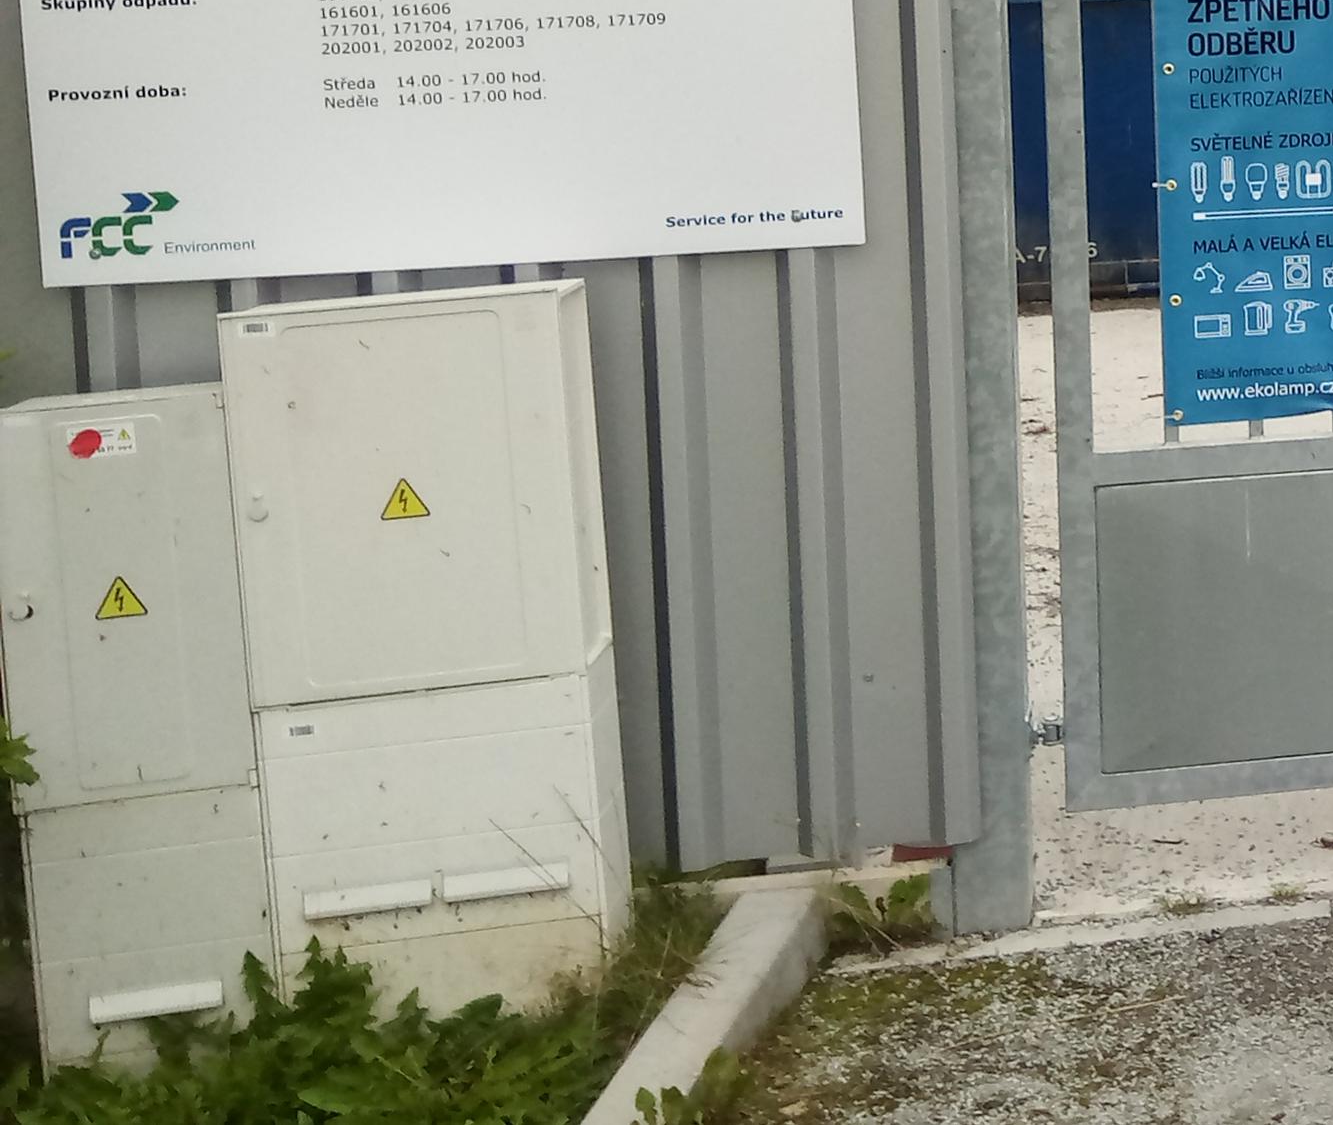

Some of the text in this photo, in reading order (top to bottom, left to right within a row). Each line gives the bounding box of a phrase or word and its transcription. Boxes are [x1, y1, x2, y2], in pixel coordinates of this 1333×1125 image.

[320, 3, 451, 20] 161601, 161606
[321, 12, 666, 37] 171701, 171704, 171706, 171708, 171709
[321, 35, 525, 56] 202001, 202002, 202003
[1188, 27, 1295, 56] ODBĚRU
[323, 71, 546, 92] Středa 14.00 17.00 hod.
[1190, 64, 1282, 84] POUŽITÝCH
[48, 85, 187, 102] Provozní doba:
[324, 89, 547, 109] Neděle 14.00 17.00 hod.
[1191, 131, 1273, 152] SVĚTELNÉ
[665, 214, 726, 228] Service
[731, 212, 754, 224] for
[760, 210, 785, 222] the
[60, 214, 256, 260] FCC Environment
[1193, 234, 1238, 254] MALÁ
[1243, 239, 1255, 251] A
[1260, 231, 1310, 251] VELKÁ
